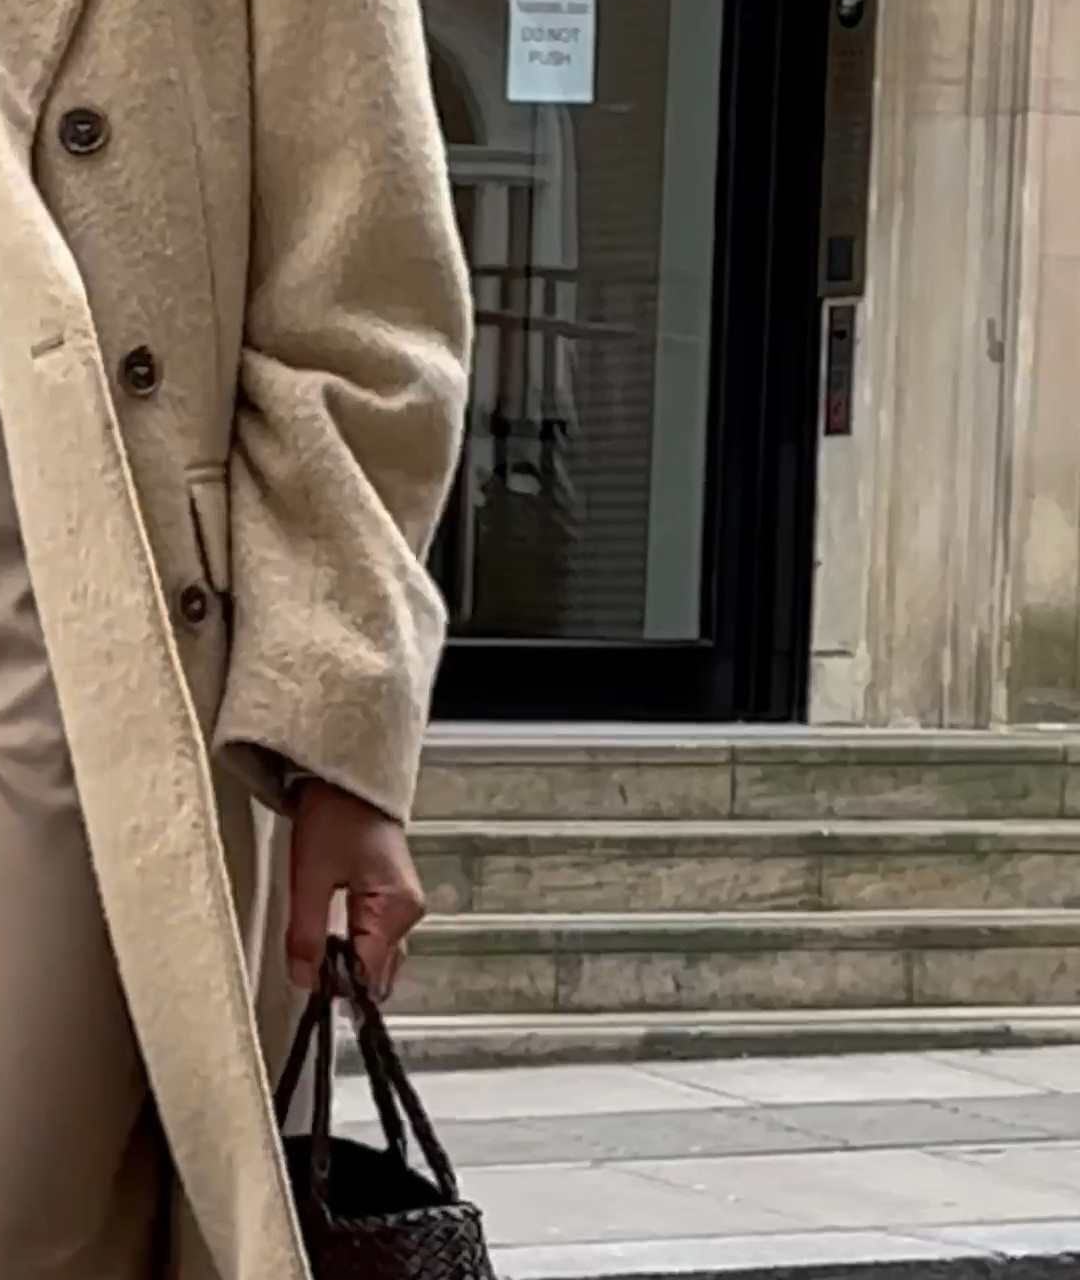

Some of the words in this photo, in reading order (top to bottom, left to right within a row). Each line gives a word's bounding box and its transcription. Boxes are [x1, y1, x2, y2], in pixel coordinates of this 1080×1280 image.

[521, 26, 543, 42] DO
[547, 26, 581, 44] NOT
[528, 51, 572, 66] PUSH
